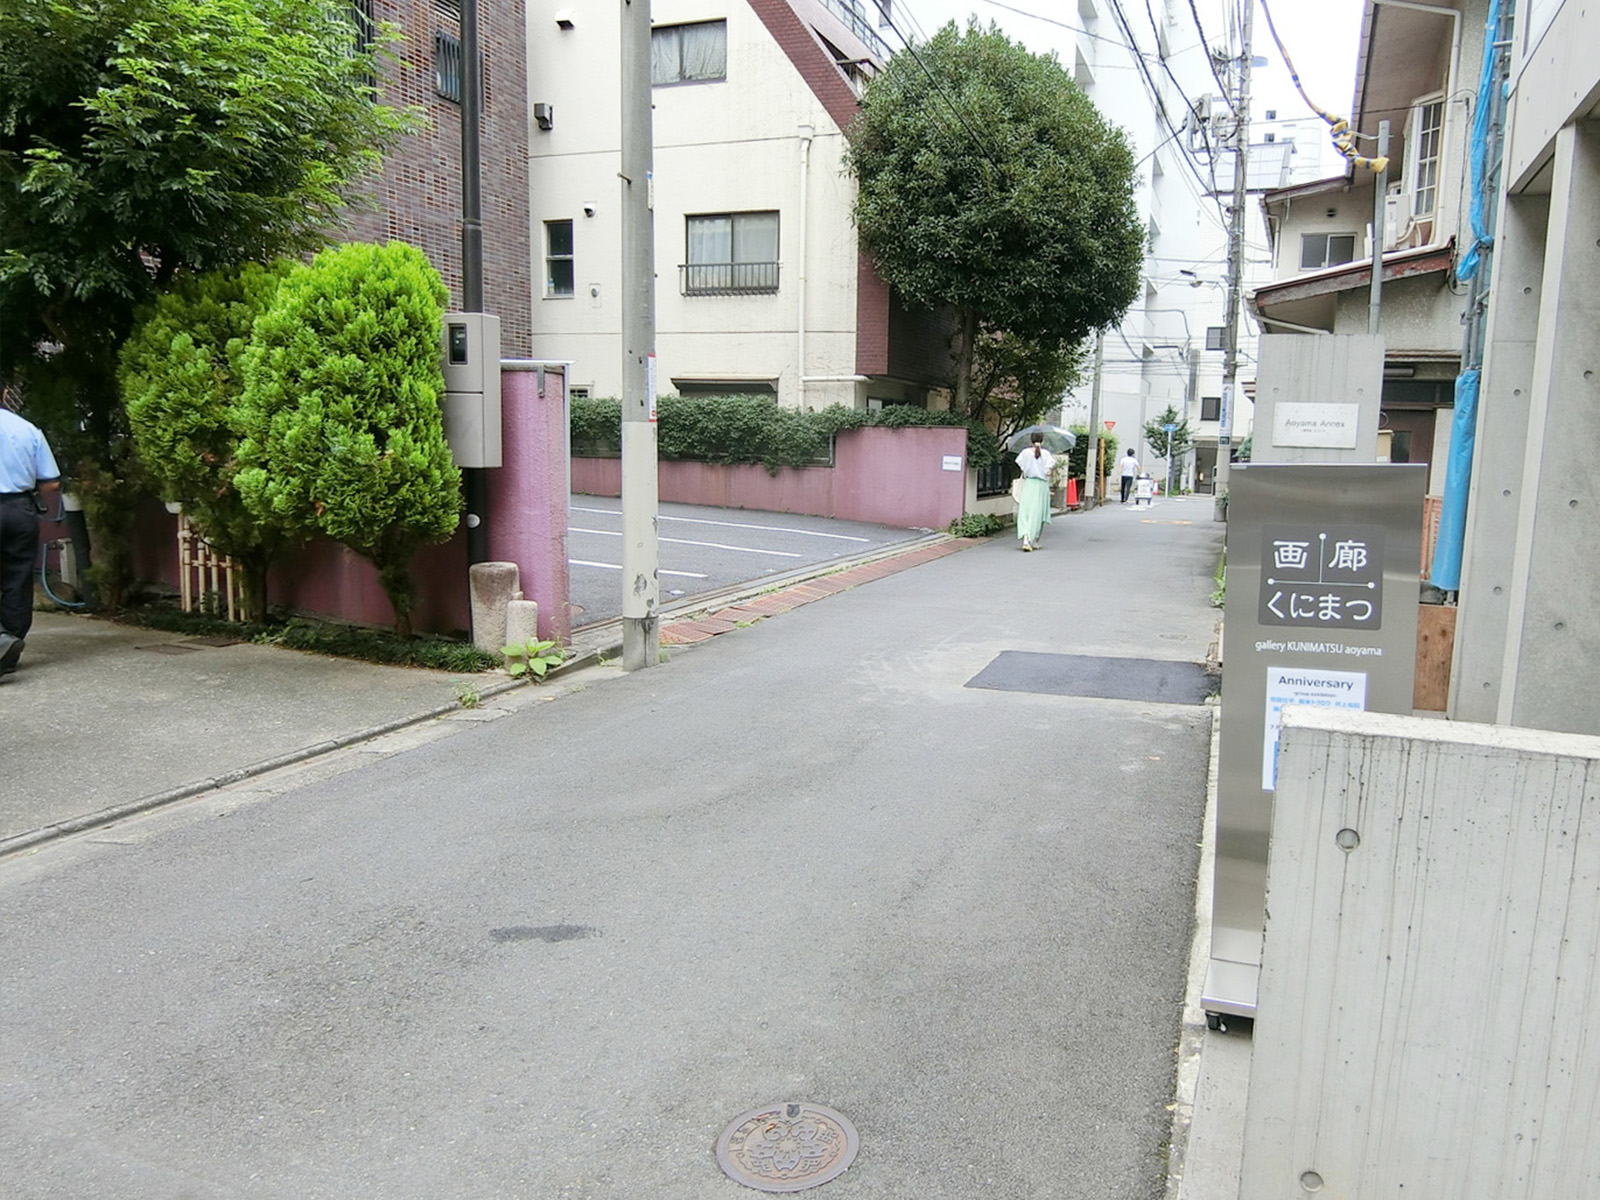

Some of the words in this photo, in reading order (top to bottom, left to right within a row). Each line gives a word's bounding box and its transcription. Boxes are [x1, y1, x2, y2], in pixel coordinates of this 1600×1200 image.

[1285, 418, 1317, 428] Aoyama
[1320, 420, 1345, 428] Annex
[1273, 539, 1368, 571] 画廊
[1266, 592, 1373, 622] くにまつ
[1255, 640, 1286, 653] gallery
[1287, 641, 1344, 654] KUNIMATSU
[1345, 646, 1383, 657] aoyama
[1278, 675, 1354, 691] Anniversary
